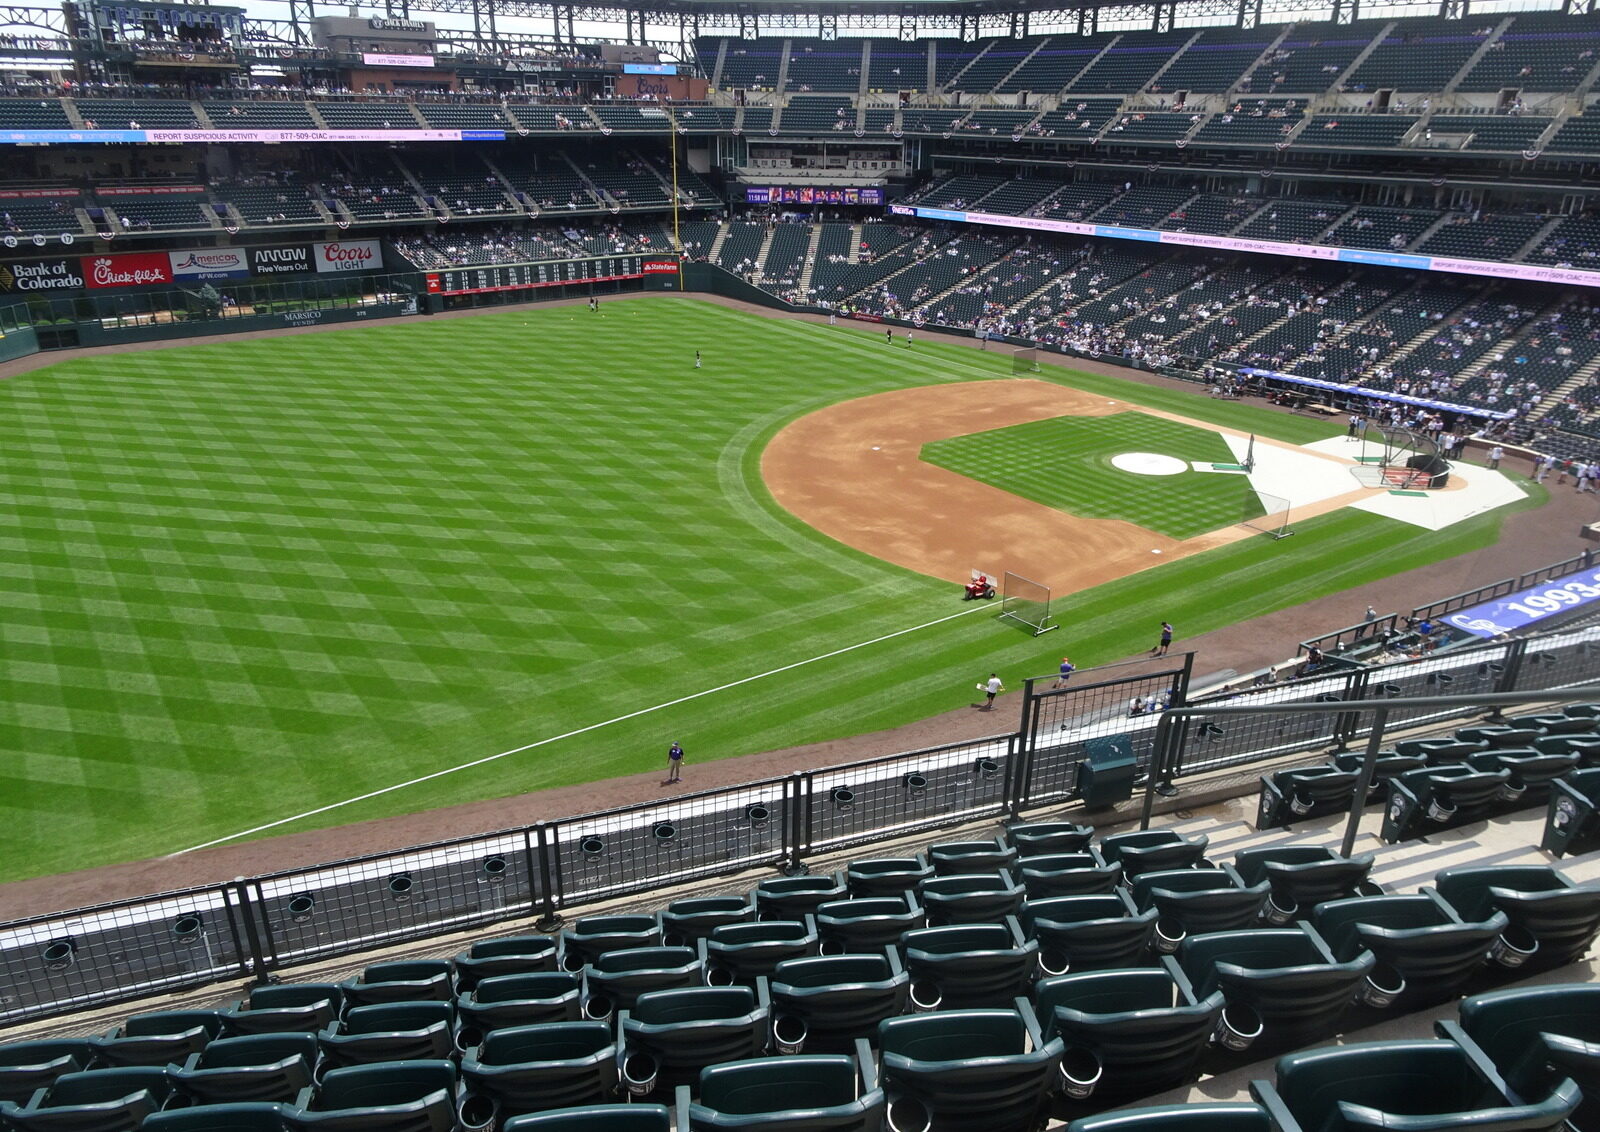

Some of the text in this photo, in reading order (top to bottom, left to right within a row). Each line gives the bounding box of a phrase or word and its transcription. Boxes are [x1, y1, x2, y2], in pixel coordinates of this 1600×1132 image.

[101, 6, 140, 24] THE
[384, 18, 401, 27] JACK
[637, 77, 668, 95] Coors
[255, 248, 307, 263] ARROW
[323, 243, 374, 262] Coors
[14, 260, 67, 277] Bank of
[94, 261, 165, 285] Chick-fil-A
[257, 262, 308, 273] Five Years Out
[335, 260, 365, 271] LIGHT
[1456, 264, 1491, 272] SUSPICIOUS
[1536, 271, 1582, 281] 877-509-CIAC
[17, 274, 83, 290] Colorado
[284, 311, 322, 321] MARSICO
